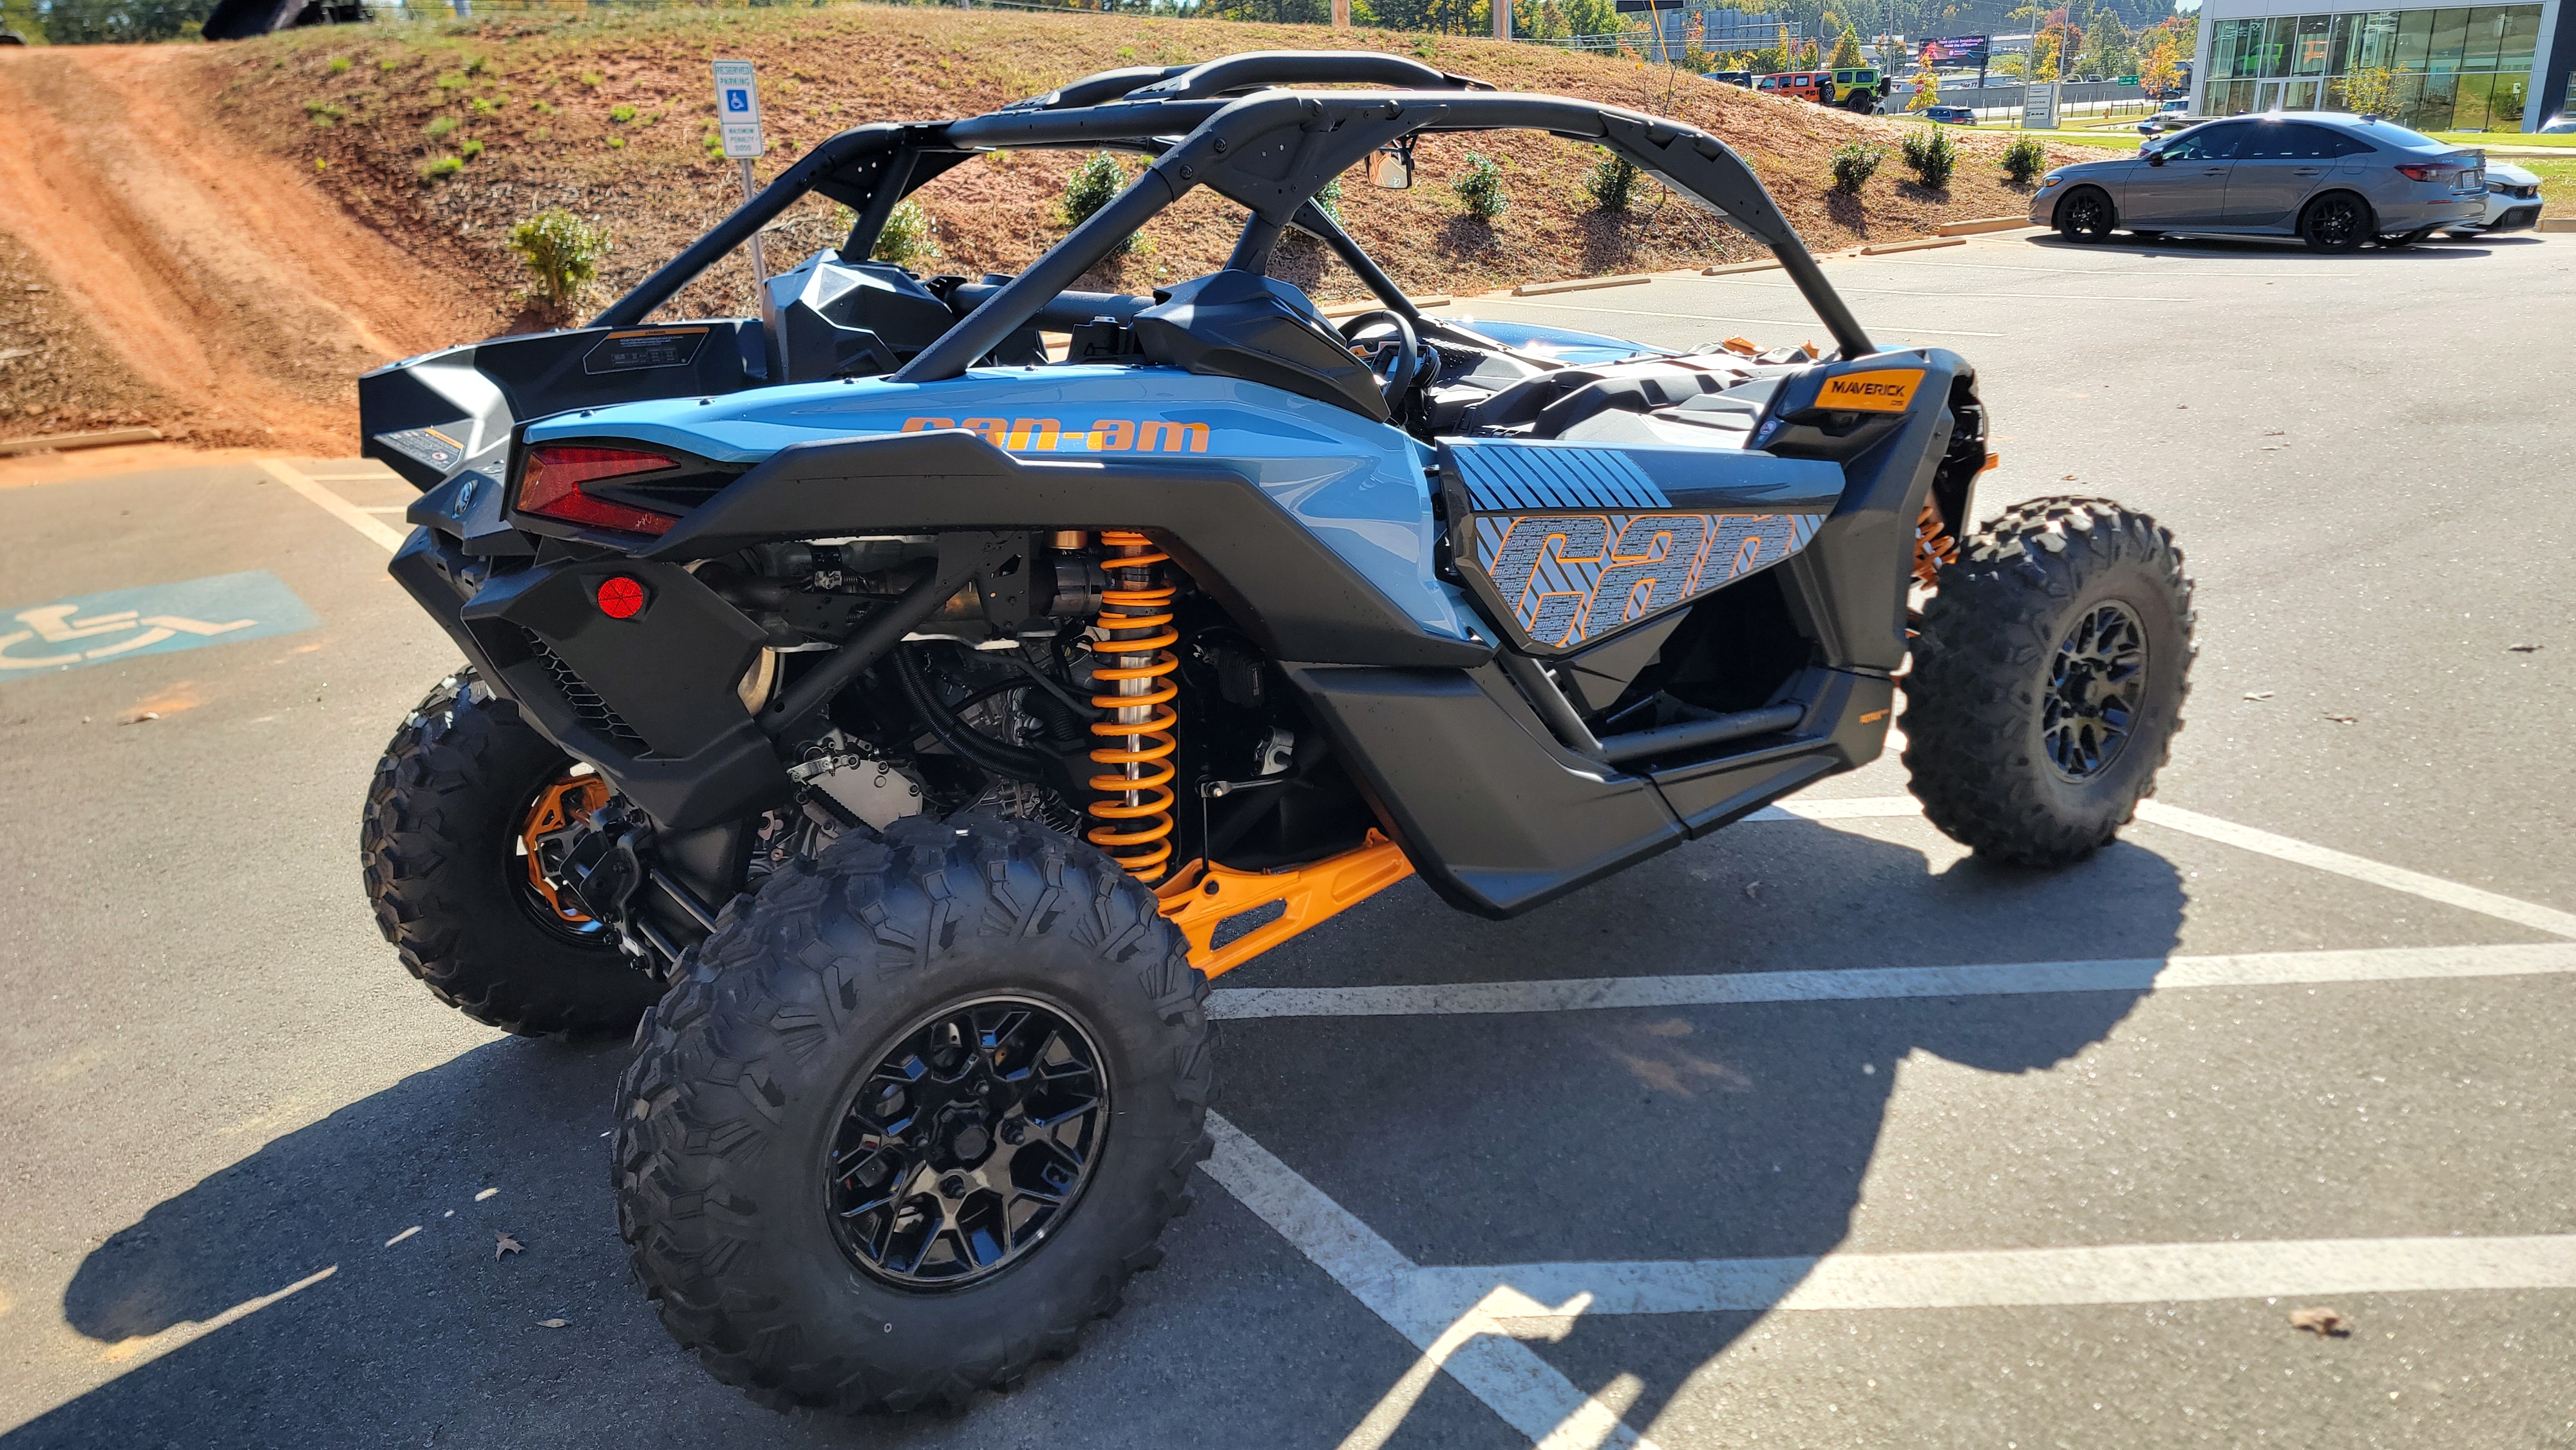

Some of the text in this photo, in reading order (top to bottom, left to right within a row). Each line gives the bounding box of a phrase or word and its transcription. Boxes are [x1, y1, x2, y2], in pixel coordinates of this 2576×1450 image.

[715, 66, 750, 75] RESERVED
[719, 78, 750, 86] PARKING
[1832, 381, 1906, 397] MAVERICK
